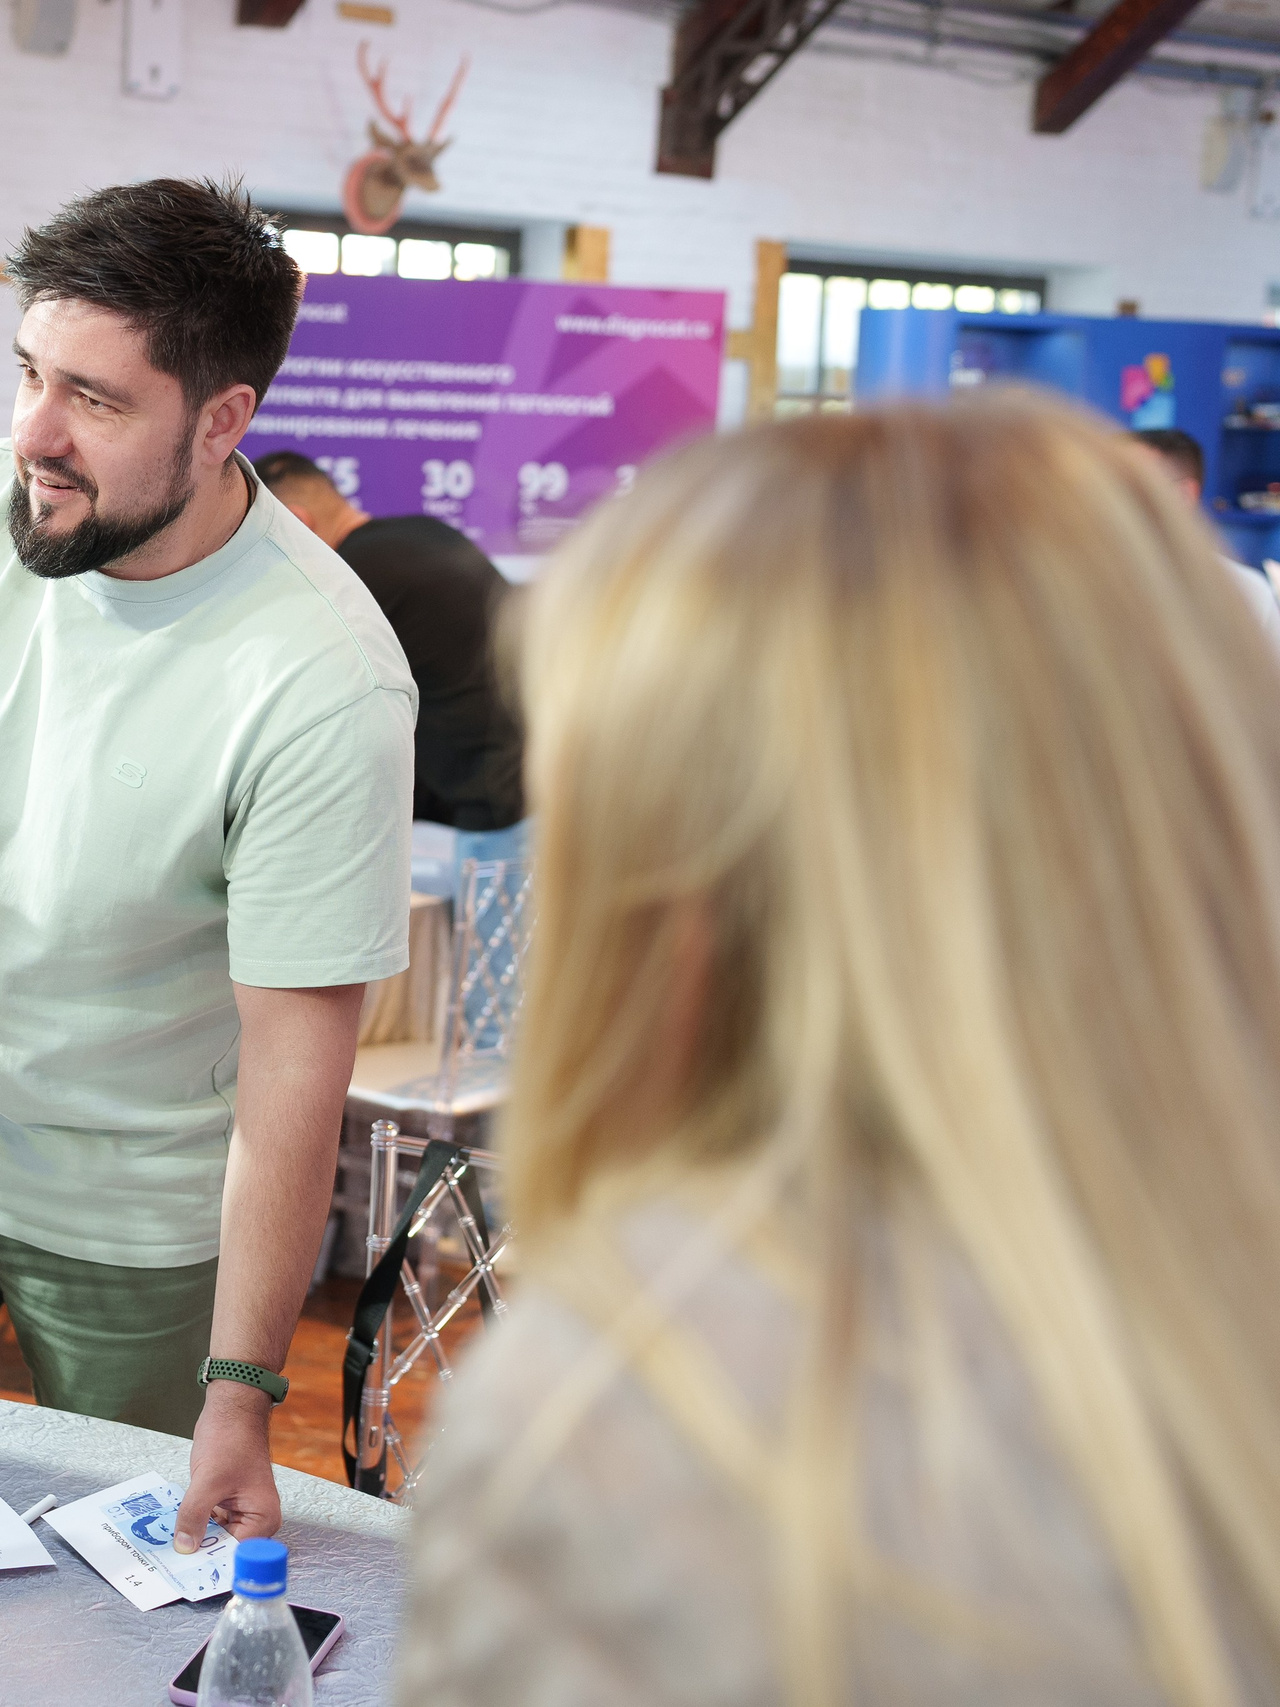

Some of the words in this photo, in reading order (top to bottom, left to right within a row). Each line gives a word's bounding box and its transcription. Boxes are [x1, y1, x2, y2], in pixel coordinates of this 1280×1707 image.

[346, 359, 515, 387] искусственного
[342, 388, 384, 411] для
[386, 388, 501, 413] выявления
[504, 391, 616, 418] патологий
[390, 418, 484, 443] лечения
[422, 459, 474, 500] 30
[518, 460, 569, 502] 99
[102, 1523, 132, 1550] прибором
[130, 1550, 149, 1566] точки
[125, 1575, 142, 1586] 1.4
